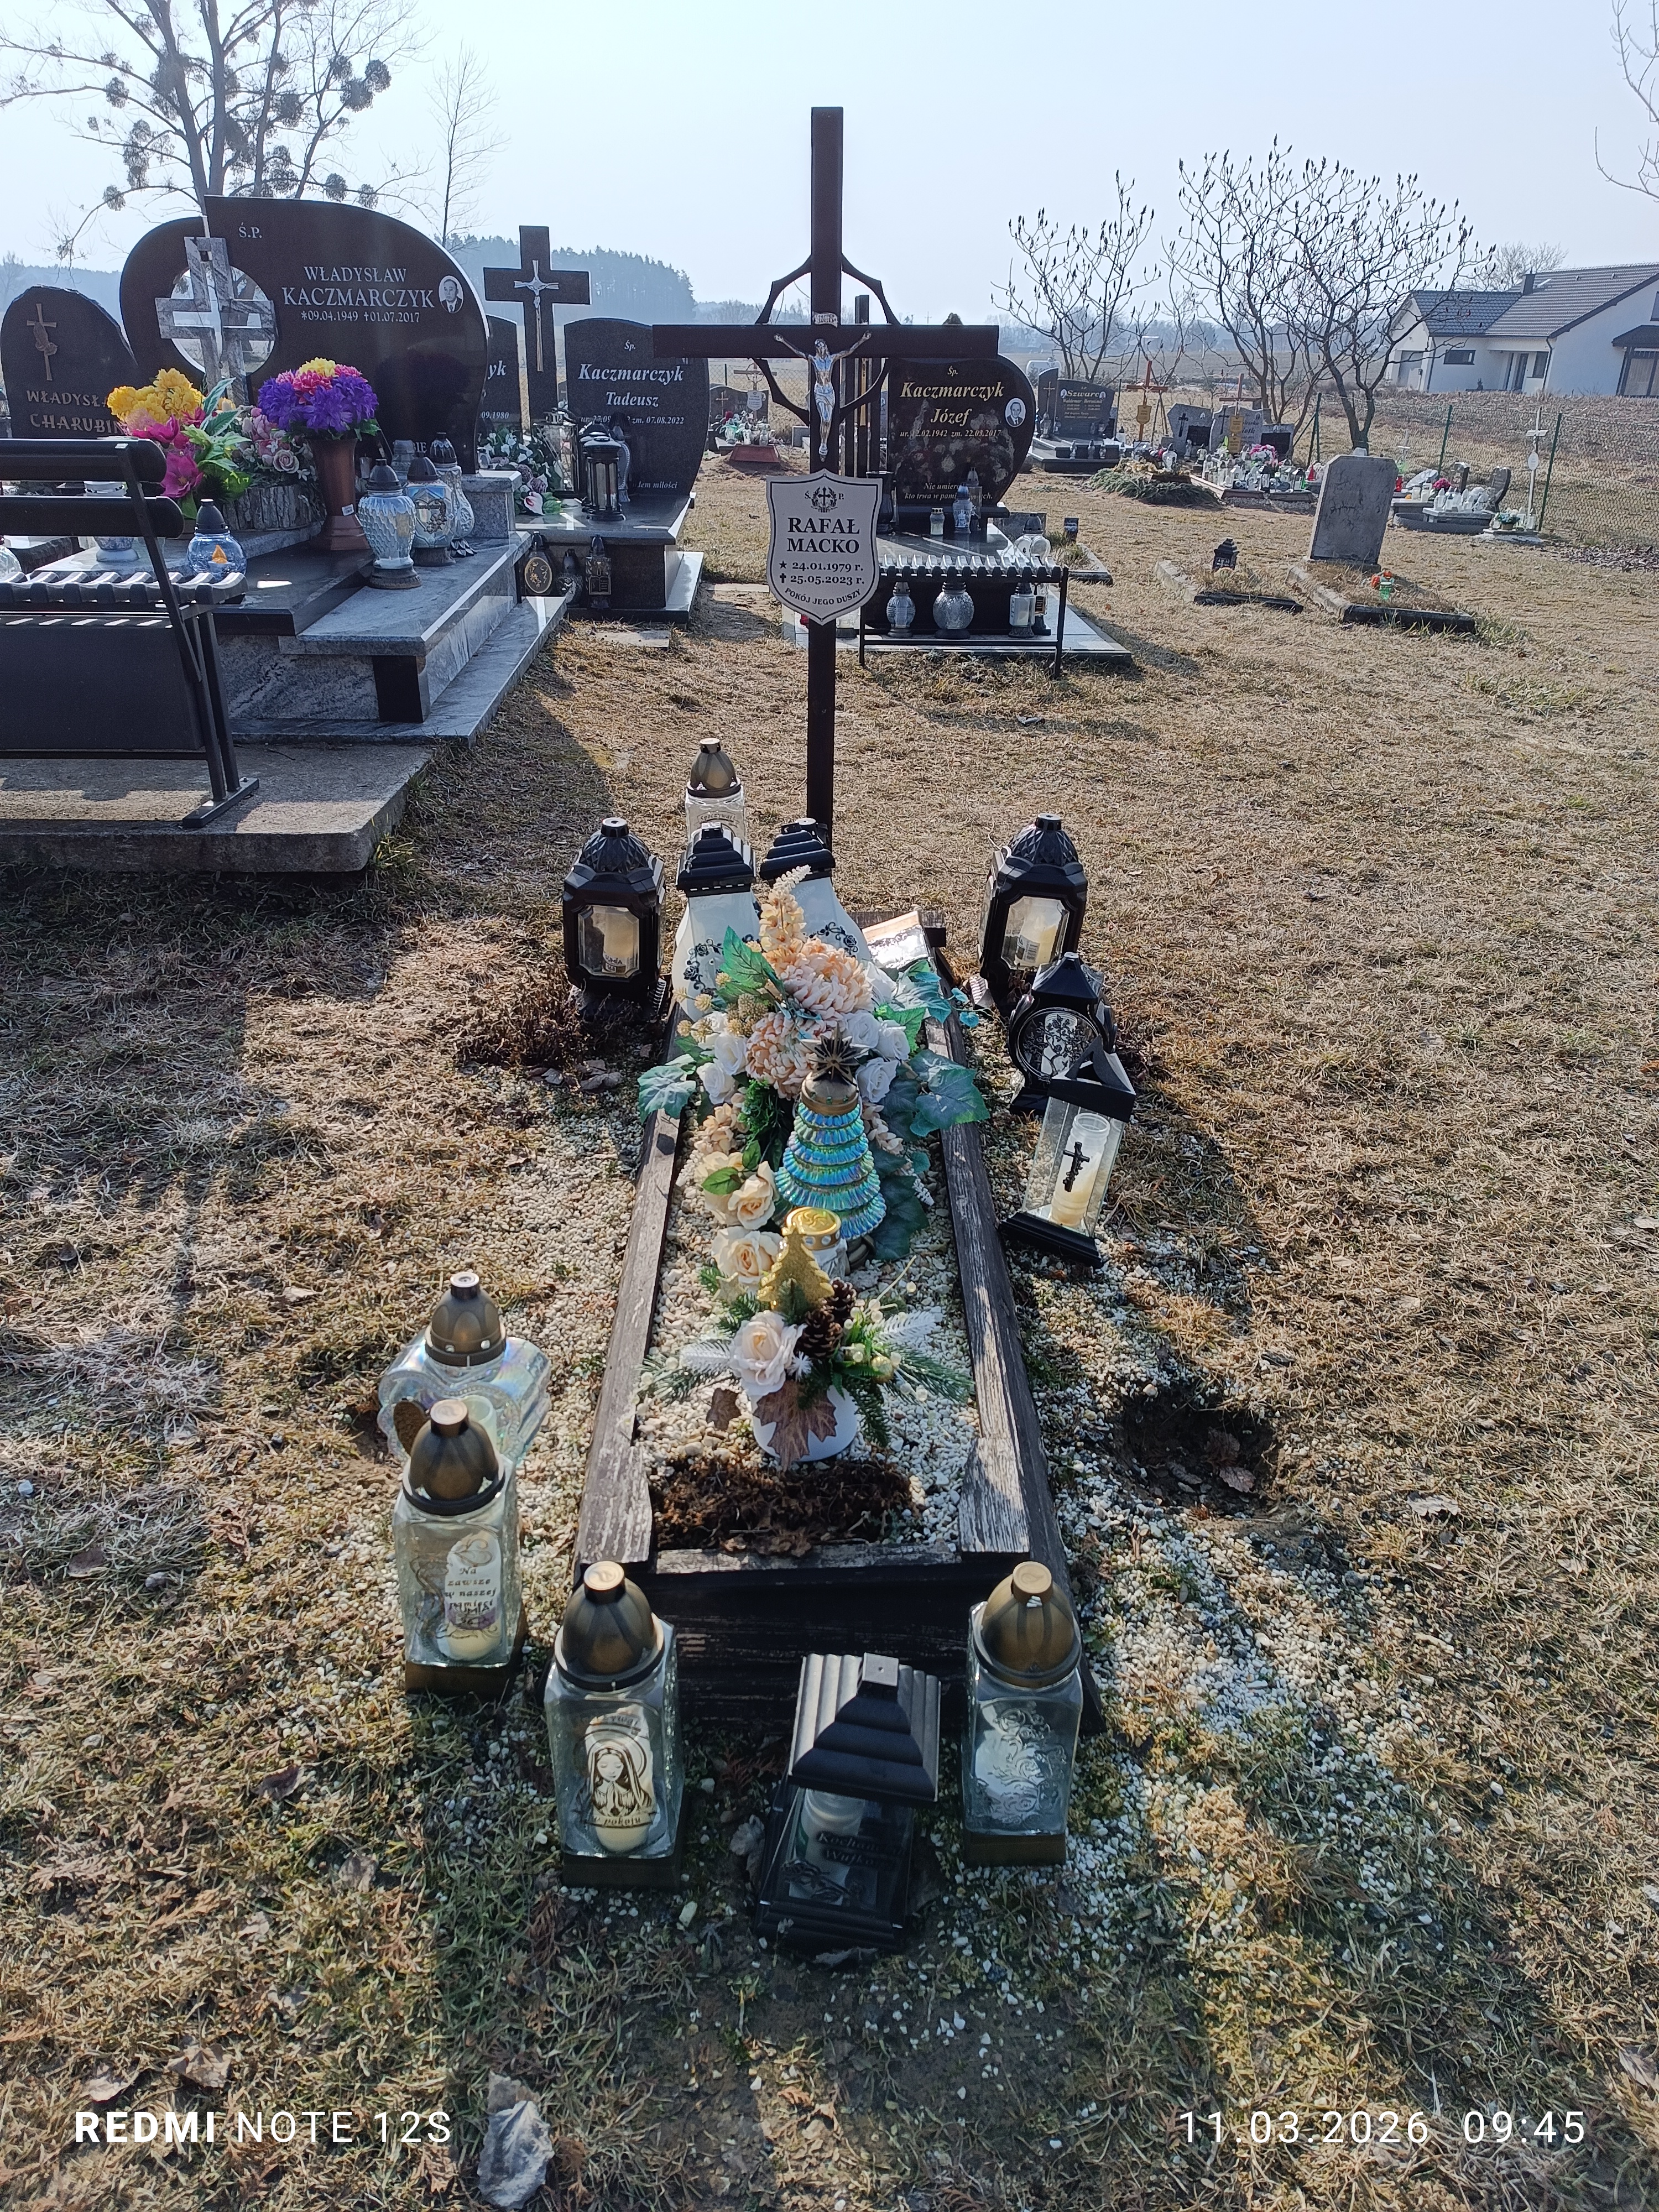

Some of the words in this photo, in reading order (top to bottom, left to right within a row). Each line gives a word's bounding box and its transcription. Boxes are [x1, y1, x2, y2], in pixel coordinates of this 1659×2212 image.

[238, 222, 263, 238] Ś.P.
[304, 266, 406, 283] WŁADYSŁAW
[281, 287, 435, 308] KACZMARCZYK
[307, 310, 358, 321] 09.04.1949
[370, 311, 420, 323] 01.07.2017
[624, 340, 636, 352] Śp.
[578, 363, 684, 385] Kaczmarczyk
[947, 366, 958, 377] Śp.
[900, 382, 1005, 401] Kaczmarczyk
[27, 390, 107, 408] WŁADYSŁ
[606, 392, 659, 408] Tadeusz
[479, 411, 509, 419] .09.1980
[930, 408, 972, 426] Józef
[653, 481, 678, 489] miłości
[940, 492, 957, 501] pami
[787, 518, 860, 534] RAFAŁ
[786, 538, 859, 554] MACKO
[792, 562, 852, 573] 24.01.1979
[790, 575, 853, 586] 25.05.2023
[785, 587, 811, 603] POKÓJ
[812, 597, 834, 606] JEGO
[836, 588, 862, 604] DUSZY
[605, 954, 623, 964] UMIA
[460, 1566, 477, 1575] Na
[447, 1578, 491, 1587] zawsze
[460, 1587, 497, 1597] naszej
